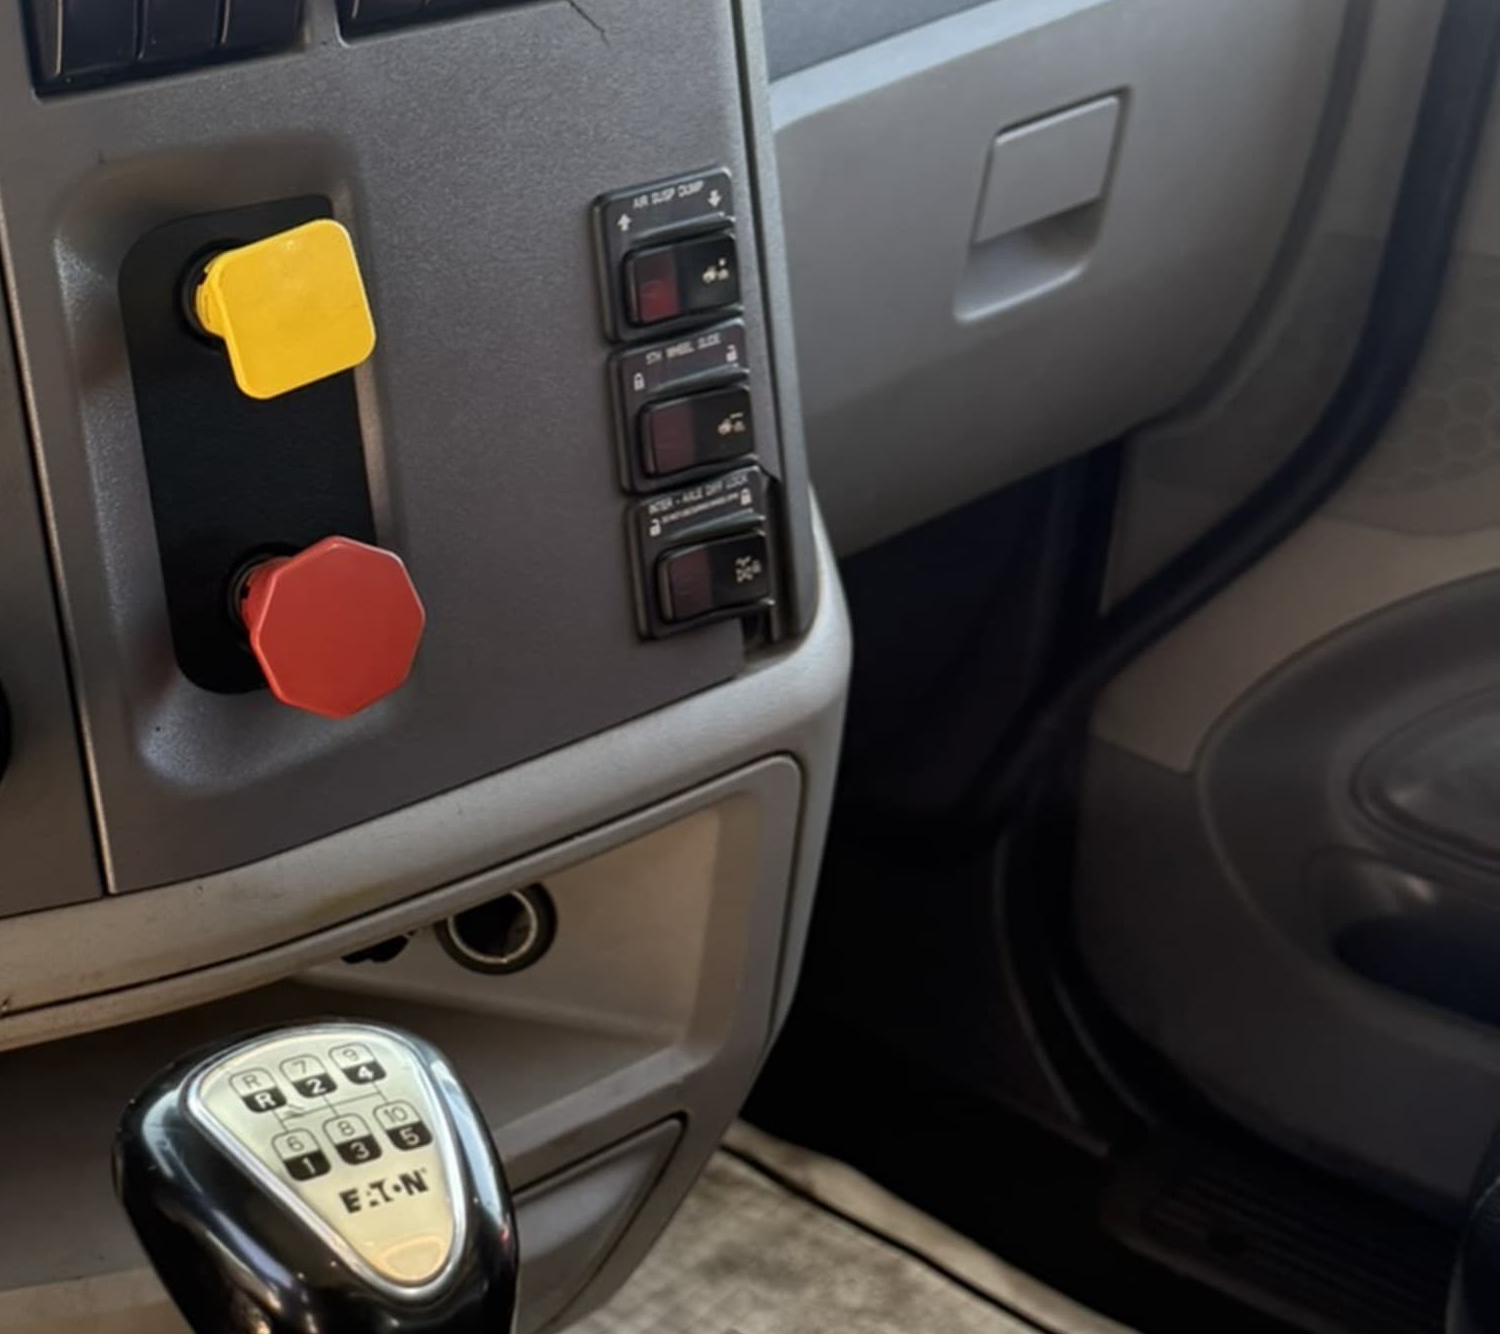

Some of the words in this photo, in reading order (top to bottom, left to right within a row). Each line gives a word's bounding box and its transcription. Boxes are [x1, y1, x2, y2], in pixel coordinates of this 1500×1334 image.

[343, 1048, 358, 1063] 9
[294, 1060, 308, 1075] 7
[357, 1066, 372, 1080] 4
[242, 1073, 258, 1088] R
[309, 1080, 326, 1094] 2
[256, 1092, 276, 1108] R
[384, 1107, 407, 1123] 10
[338, 1122, 353, 1137] 8
[289, 1137, 303, 1151] 6
[402, 1130, 419, 1146] 5
[351, 1144, 368, 1160] 3
[302, 1159, 315, 1173] 1
